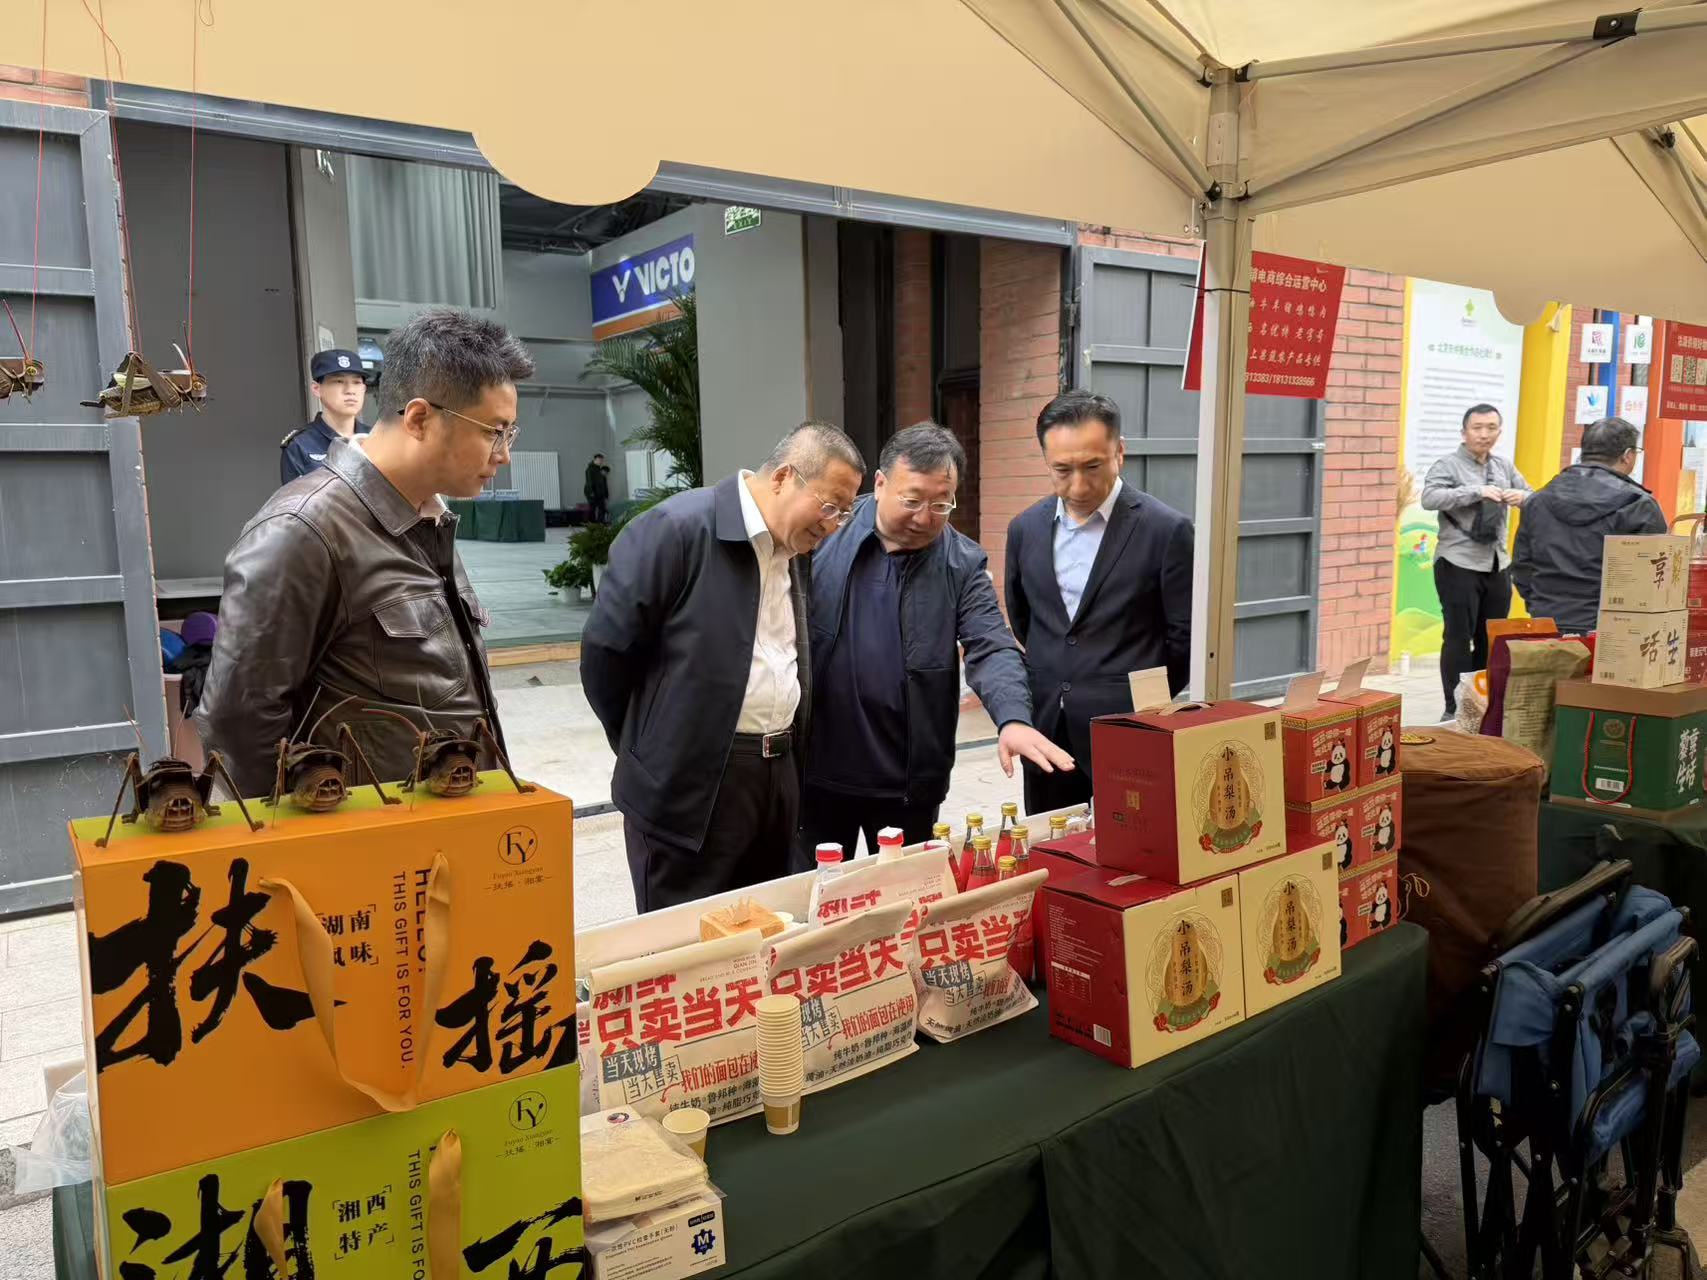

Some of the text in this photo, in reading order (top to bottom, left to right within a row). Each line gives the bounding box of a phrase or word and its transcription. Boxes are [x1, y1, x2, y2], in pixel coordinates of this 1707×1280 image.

[1222, 746, 1236, 821] 小吊梨汤
[393, 871, 406, 912] THIS
[322, 910, 371, 936] 湖南
[394, 918, 409, 956] GIFT
[89, 857, 578, 1075] 扶 摇
[396, 963, 410, 979] IS
[1177, 920, 1193, 996] 小吊梨汤
[398, 985, 412, 1021] FOR
[606, 1043, 658, 1082] 当天现烤
[408, 1149, 421, 1189] THIS
[338, 1194, 387, 1223] 湘西
[410, 1195, 423, 1231] GIFT
[339, 1222, 389, 1254] 特产
[412, 1237, 425, 1254] IS
[697, 1233, 710, 1247] M
